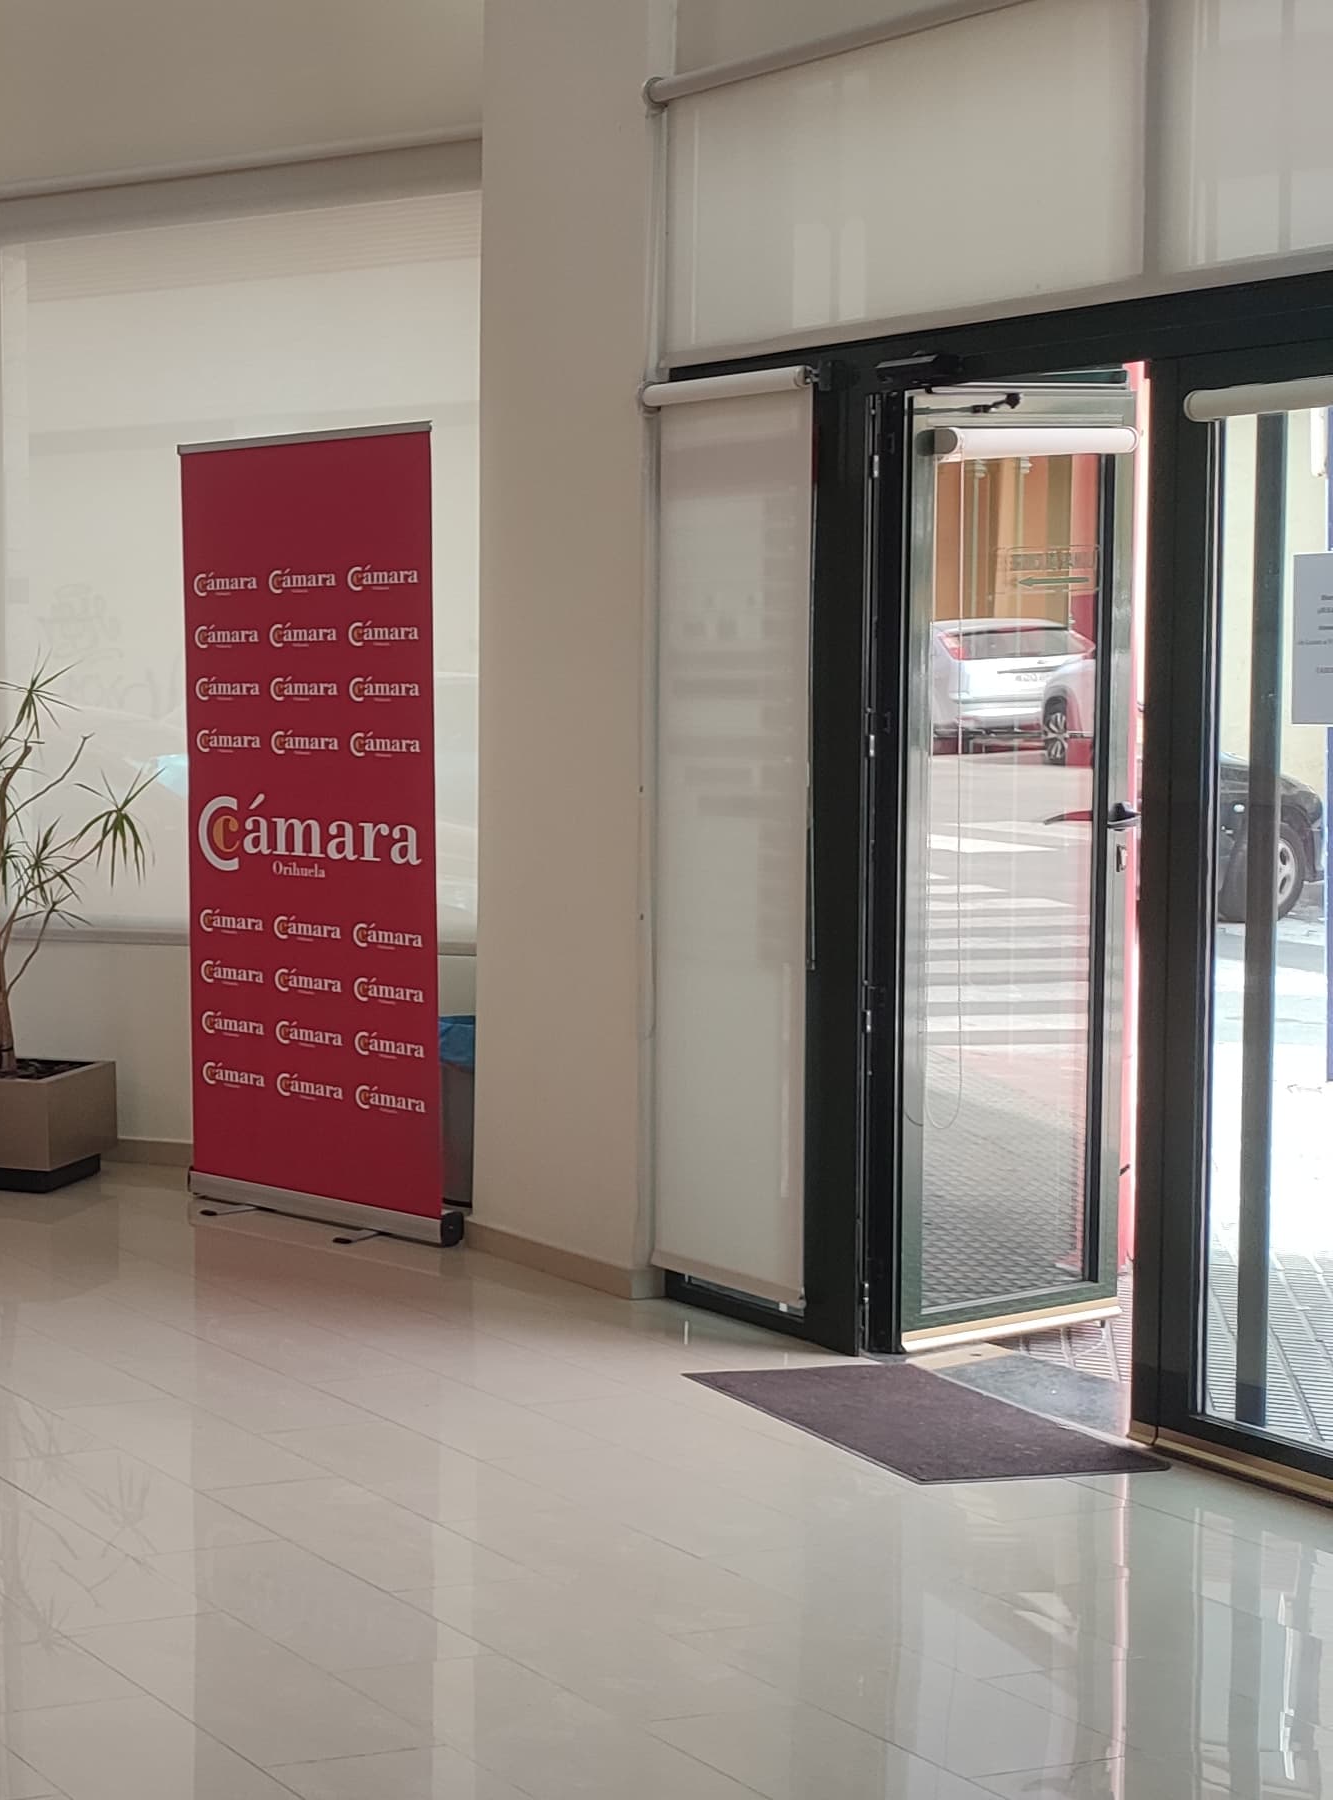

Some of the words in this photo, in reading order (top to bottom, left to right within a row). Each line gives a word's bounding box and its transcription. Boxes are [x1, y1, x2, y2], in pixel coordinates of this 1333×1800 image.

[195, 574, 257, 596] Cámara
[269, 570, 336, 593] Cámara
[348, 566, 418, 591] Cámara
[195, 626, 258, 648] Cámara
[270, 624, 336, 647] Cámara
[349, 622, 418, 646] Cámara
[196, 678, 259, 700] Cámara
[270, 678, 337, 701] Cámara
[349, 678, 419, 701] Cámara
[197, 730, 260, 752] Cámara
[271, 731, 338, 754] Cámara
[350, 733, 420, 756] Cámara
[198, 795, 421, 871] Cámara
[272, 860, 326, 879] Orihuela
[200, 910, 263, 932] Cámara
[274, 917, 341, 941] Cámara
[353, 924, 422, 947] Cámara
[201, 962, 263, 983] Cámara
[275, 970, 341, 992] Cámara
[354, 978, 423, 1003] Cámara
[202, 1012, 264, 1034] Cámara
[276, 1022, 342, 1044] Cámara
[355, 1033, 424, 1056] Cámara
[203, 1063, 265, 1085] Cámara
[277, 1074, 342, 1098] Cámara
[356, 1085, 425, 1112] Cámara
